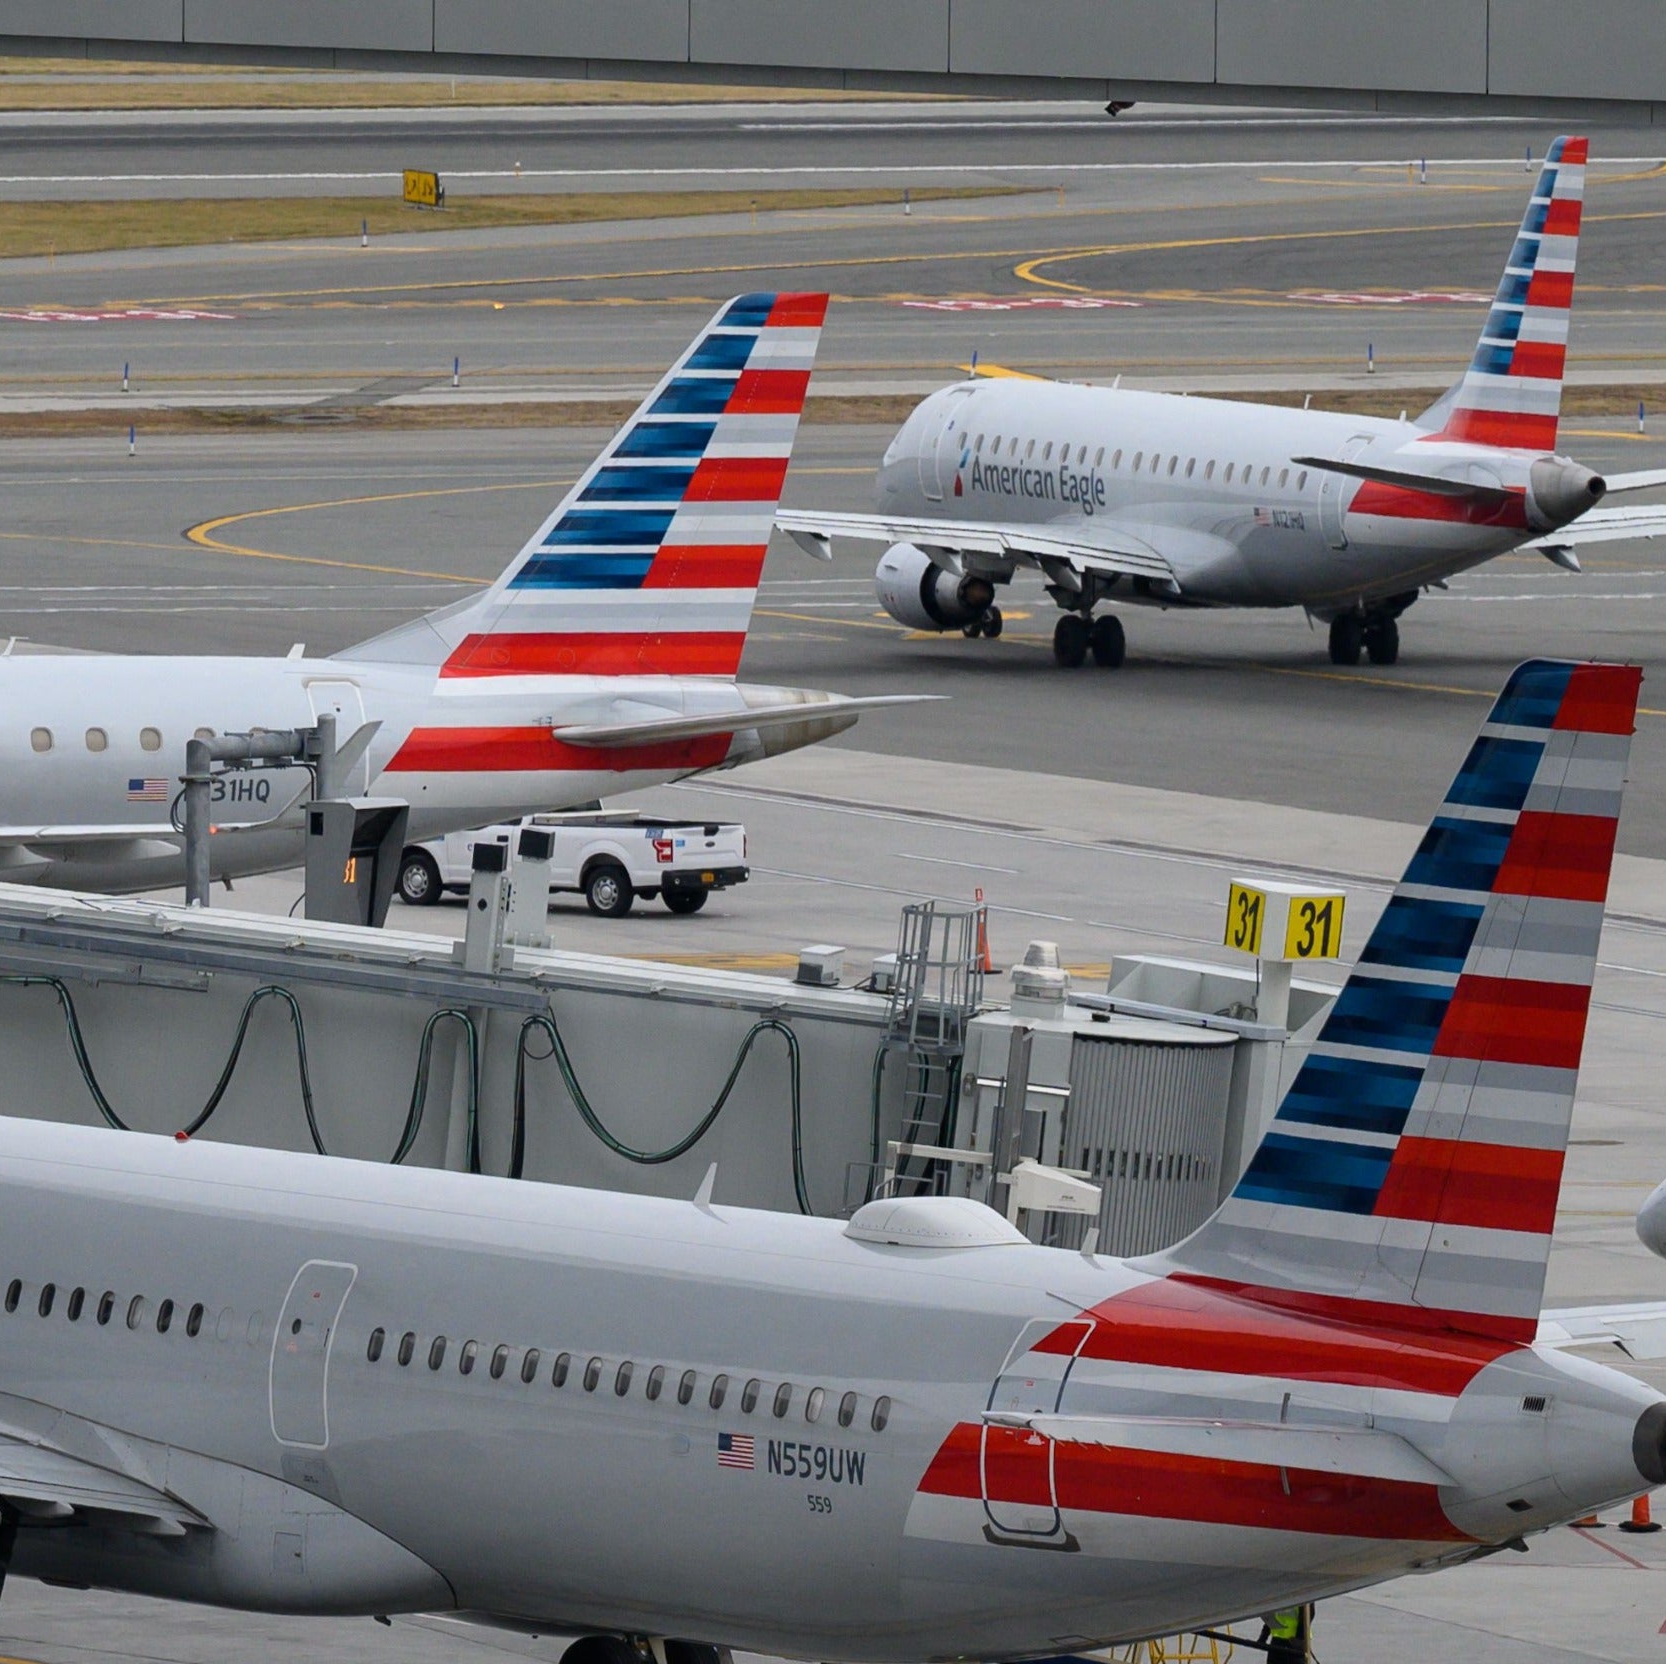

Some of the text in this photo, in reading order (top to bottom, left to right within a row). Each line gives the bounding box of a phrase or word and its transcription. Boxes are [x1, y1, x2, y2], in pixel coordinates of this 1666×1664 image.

[971, 455, 1106, 516] American Eagle
[1234, 890, 1261, 952] 31
[1296, 900, 1333, 958] 31
[767, 1439, 866, 1486] N559UW
[807, 1494, 833, 1514] 559
